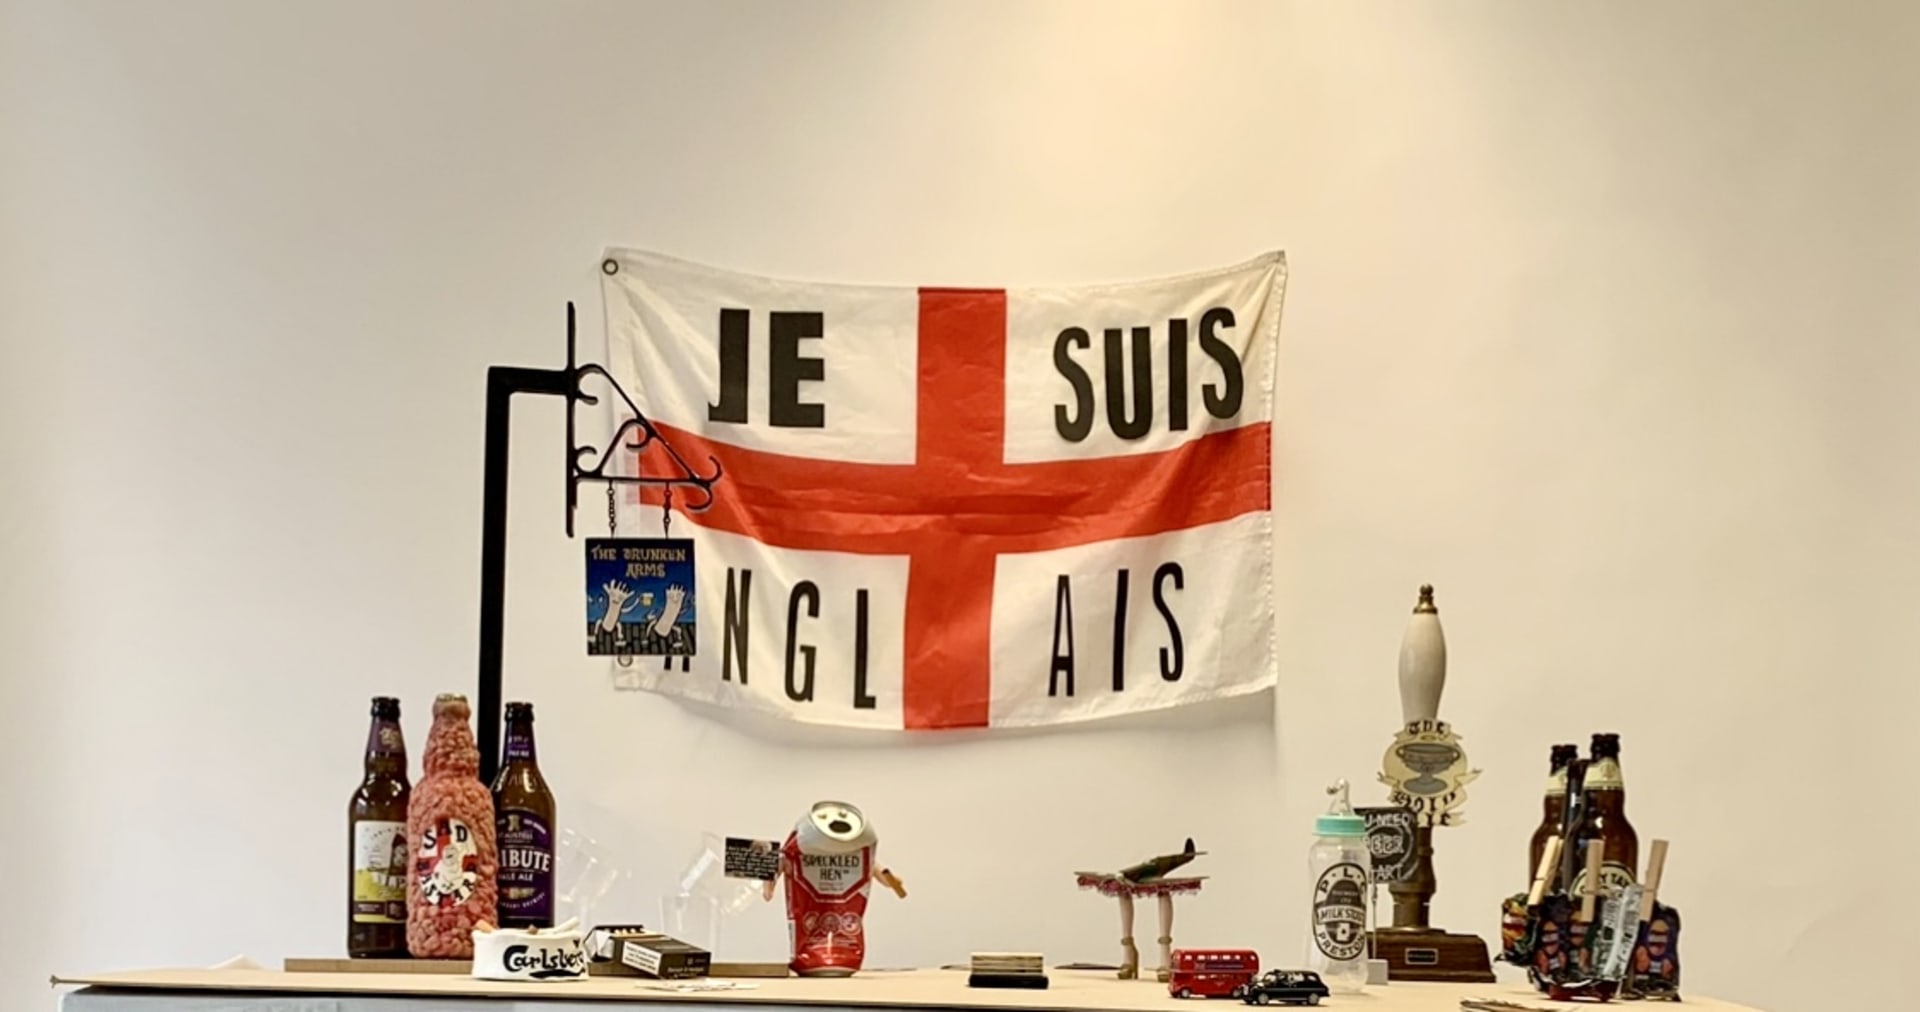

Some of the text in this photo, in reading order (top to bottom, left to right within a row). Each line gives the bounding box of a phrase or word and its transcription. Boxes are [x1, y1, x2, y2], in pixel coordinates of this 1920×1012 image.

[708, 307, 1244, 442] JE SUIS
[591, 544, 617, 560] THE
[625, 564, 666, 578] ARMS
[664, 567, 876, 710] NGL
[500, 849, 552, 873] IBUTE
